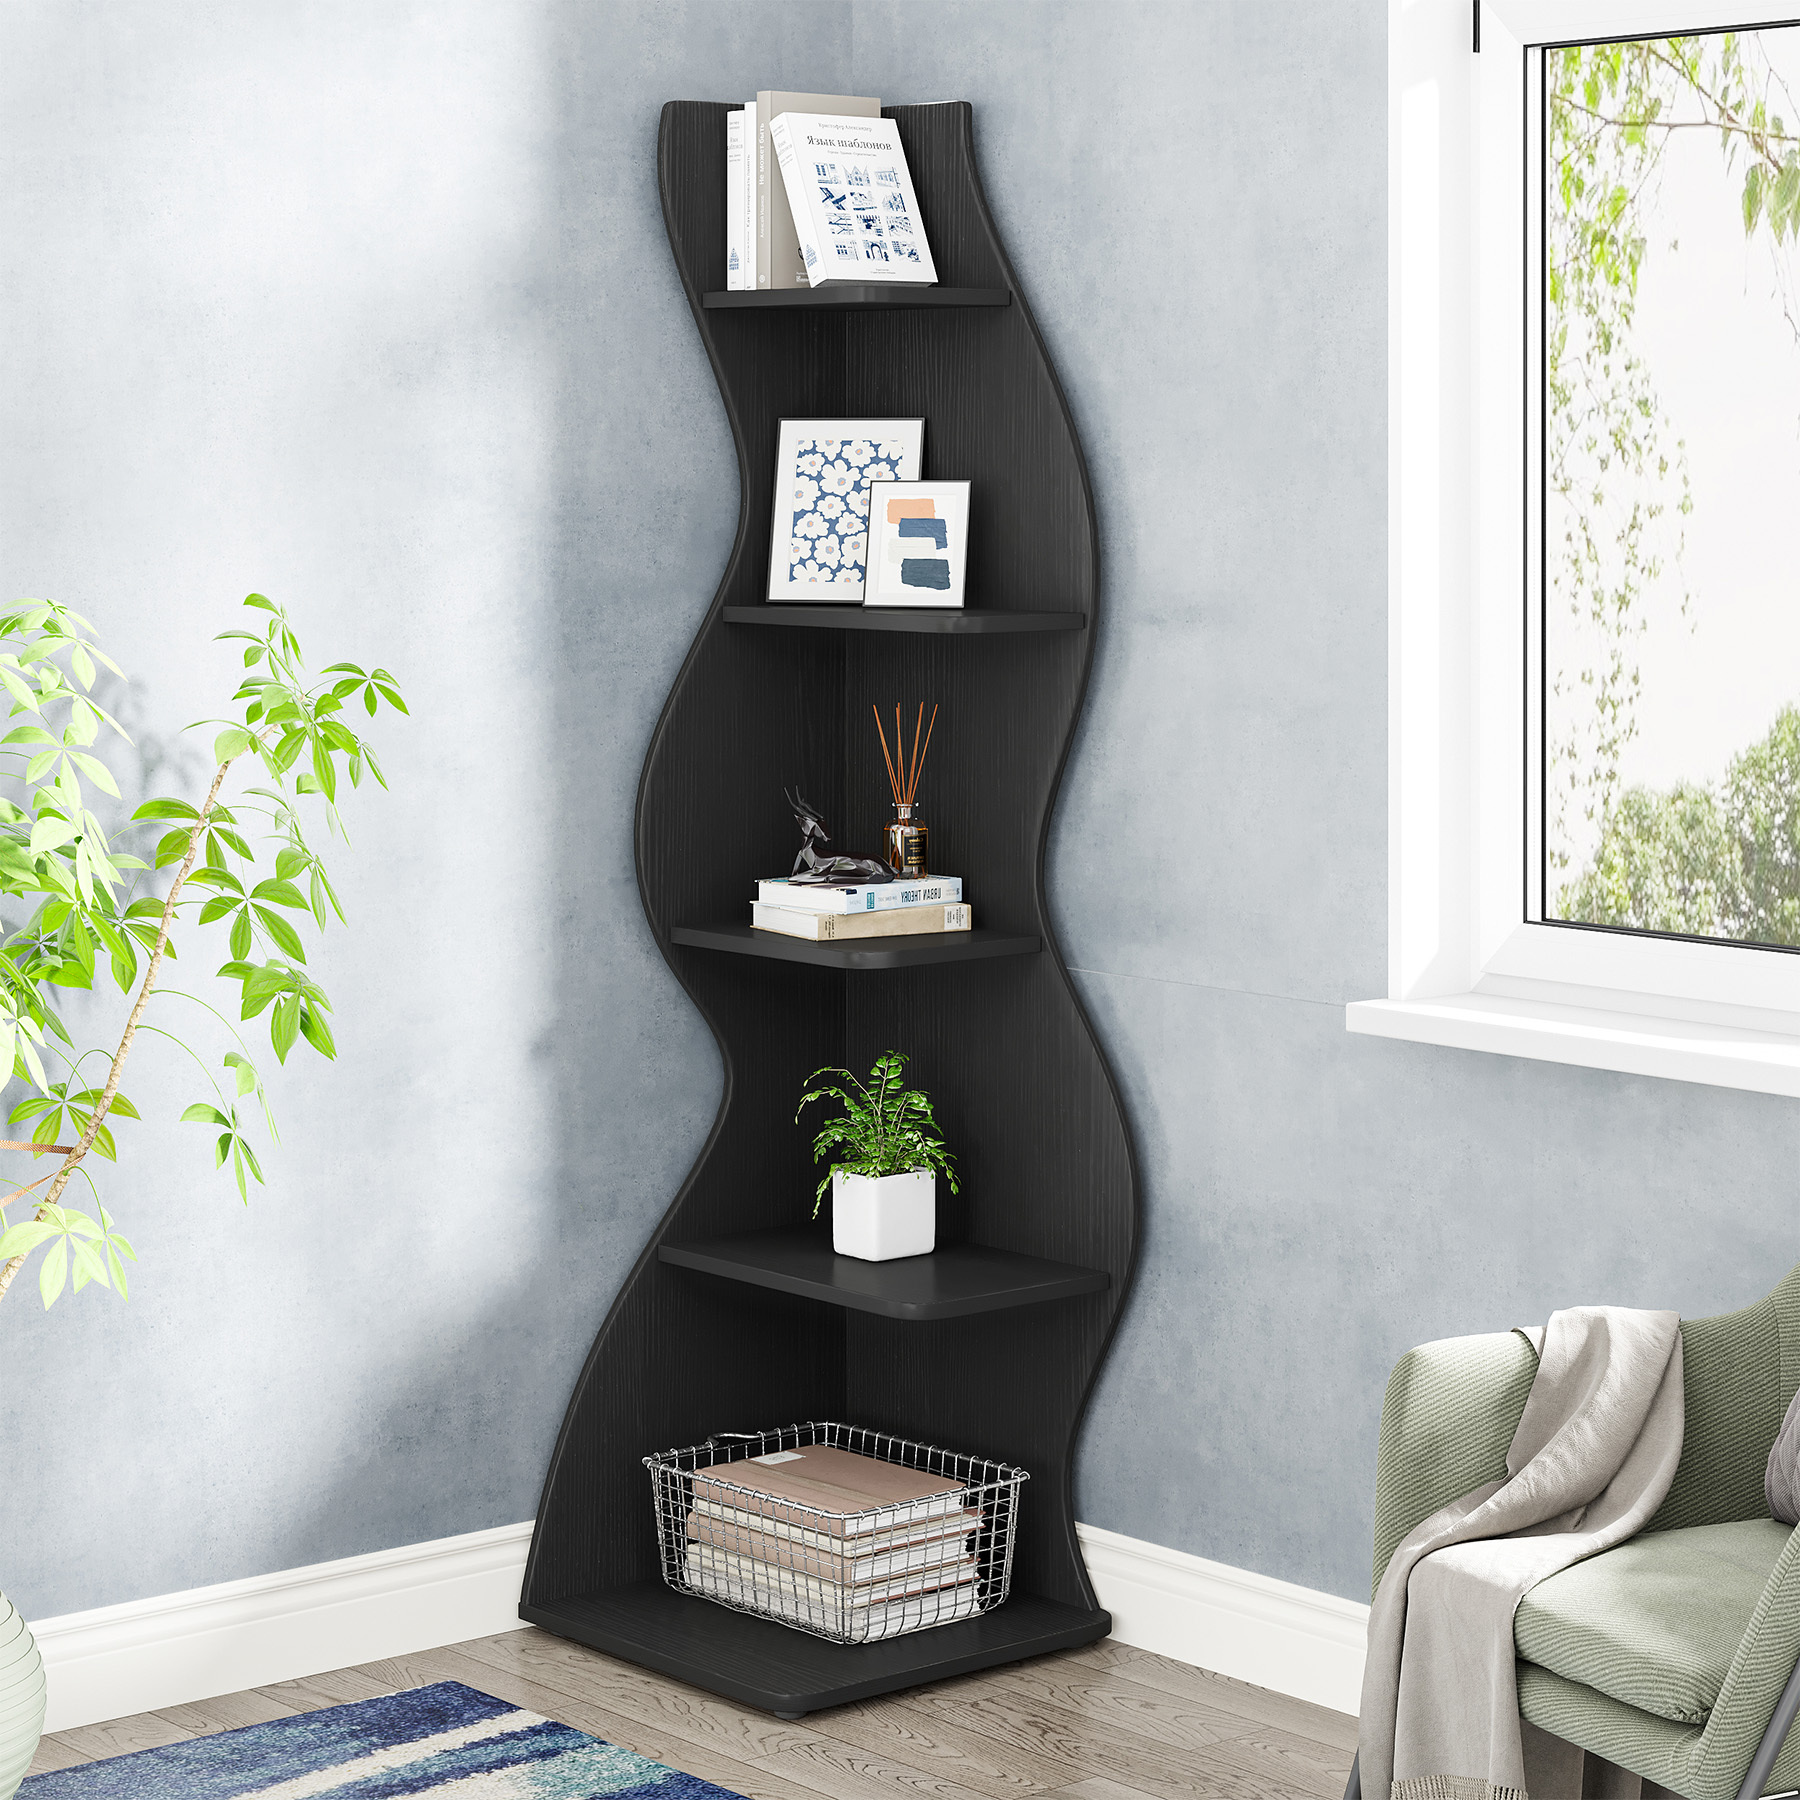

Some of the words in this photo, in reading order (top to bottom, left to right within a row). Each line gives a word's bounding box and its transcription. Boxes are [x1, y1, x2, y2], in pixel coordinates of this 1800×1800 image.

[758, 122, 766, 143] быть
[806, 135, 836, 147] Язык
[838, 138, 892, 151] шаблонов
[758, 174, 765, 186] Не
